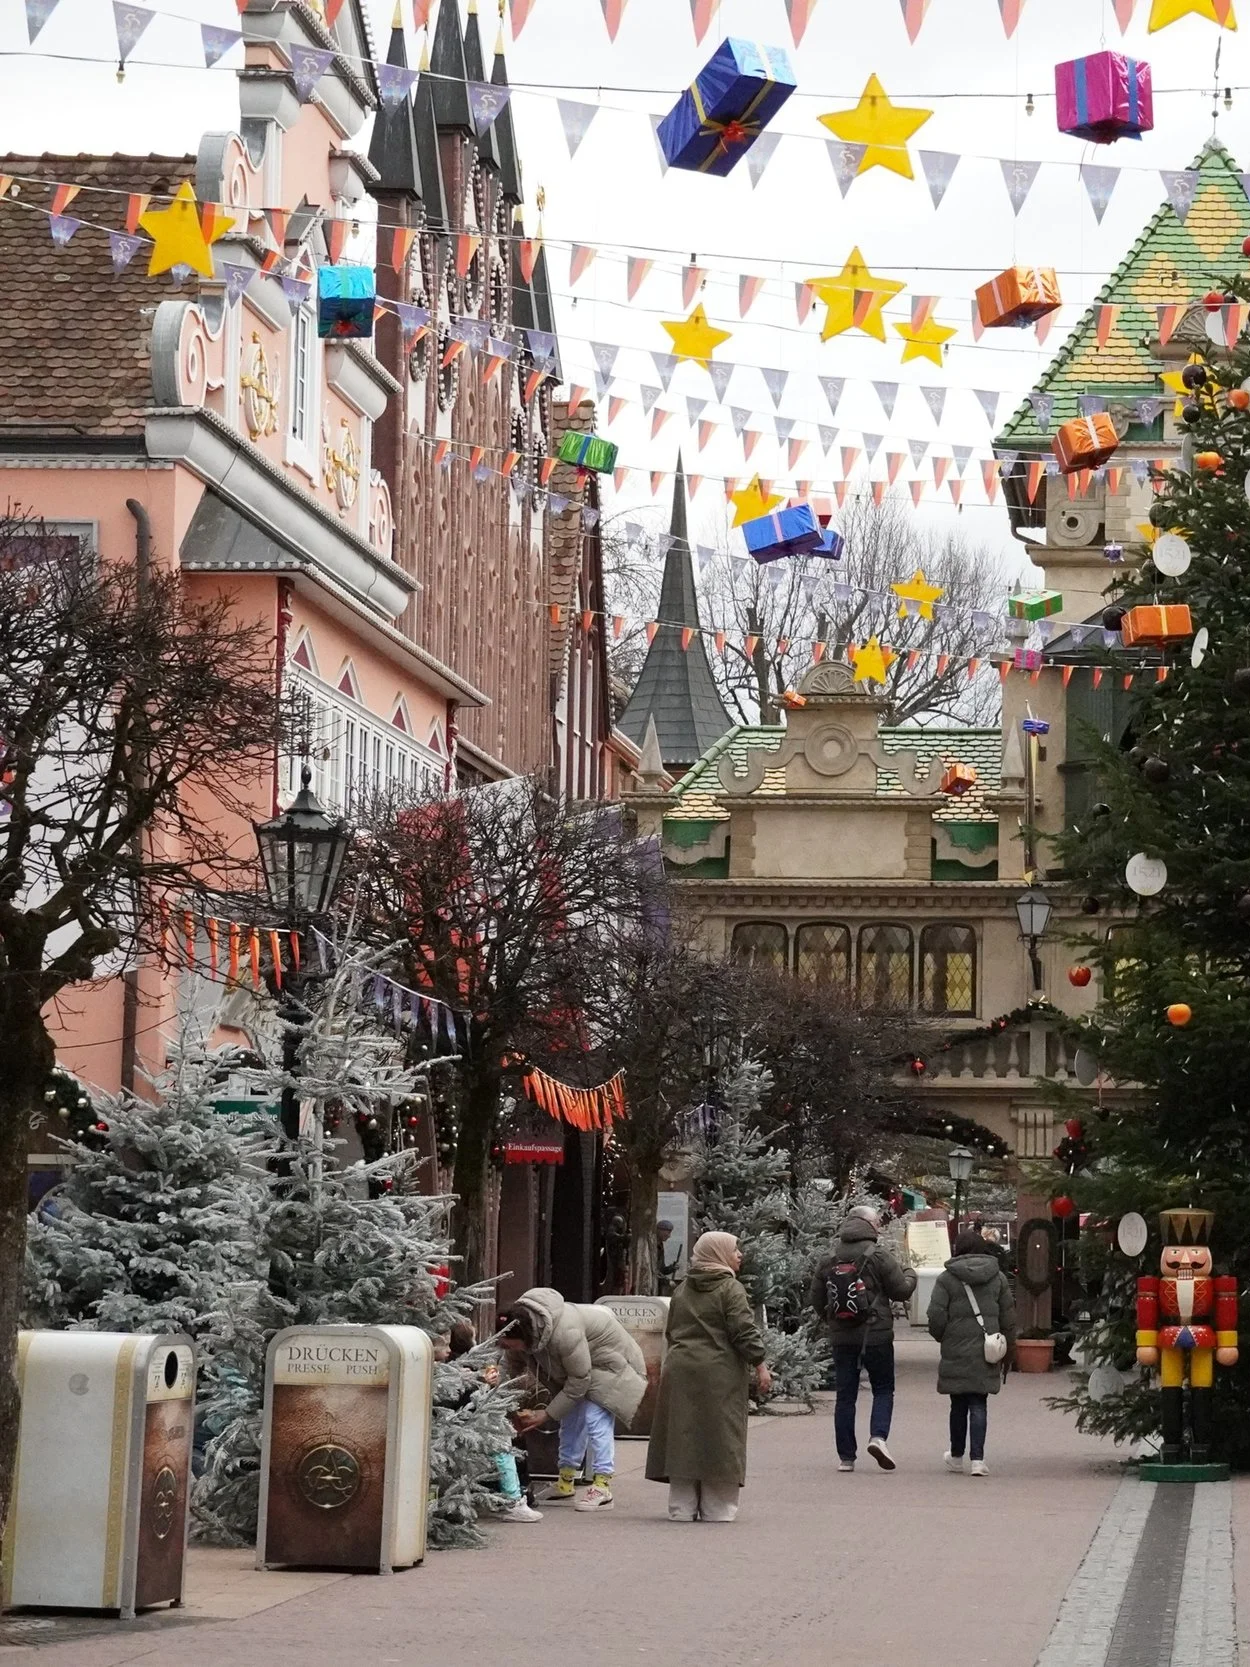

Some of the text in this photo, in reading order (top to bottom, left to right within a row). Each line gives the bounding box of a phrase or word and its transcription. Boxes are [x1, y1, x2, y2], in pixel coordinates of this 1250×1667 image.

[507, 1143, 563, 1153] Einkaufspassage
[289, 1344, 378, 1362] DRÜCKEN
[288, 1363, 378, 1375] PRESSE PUSH
